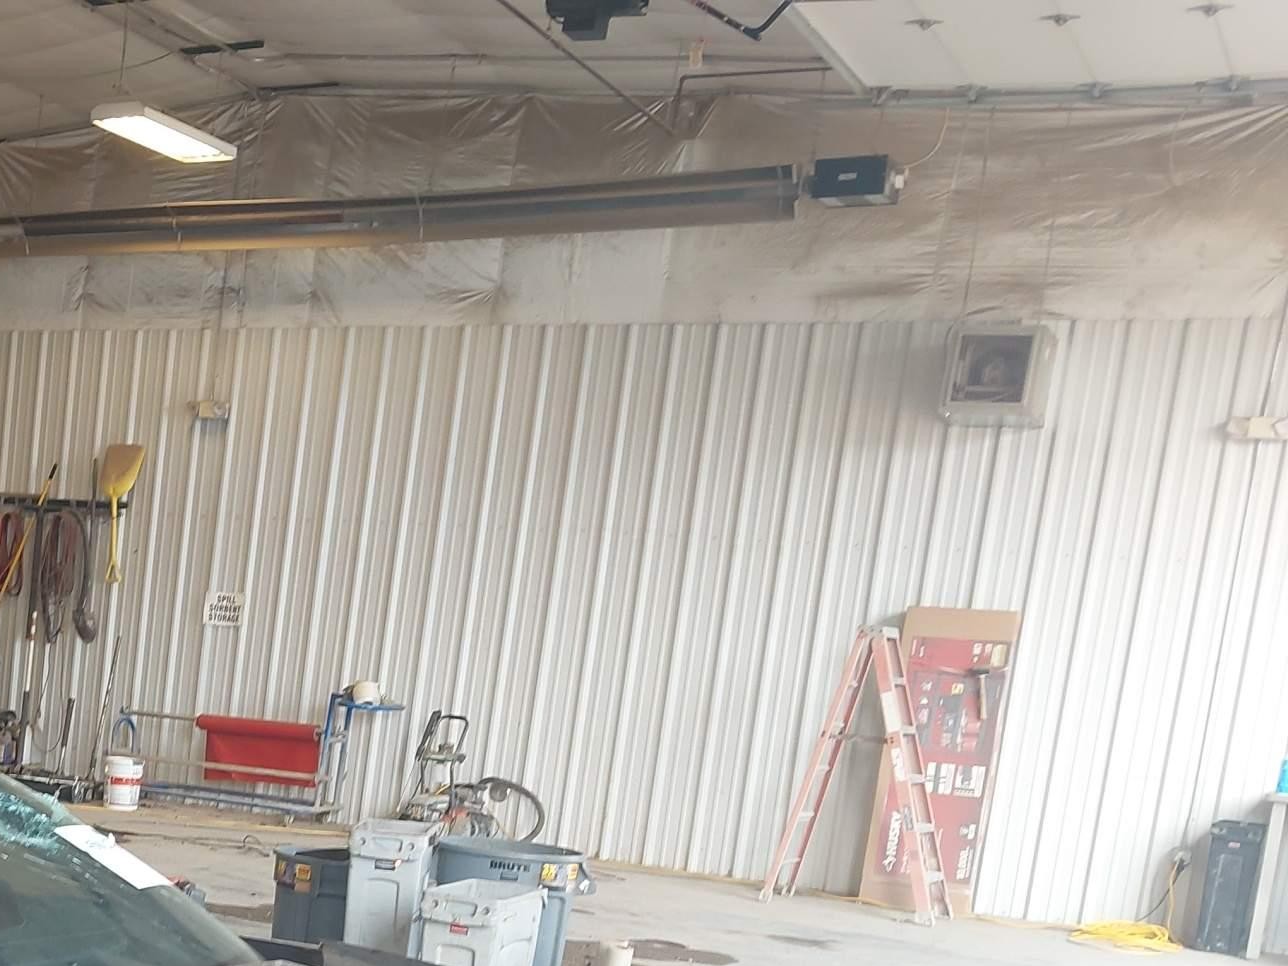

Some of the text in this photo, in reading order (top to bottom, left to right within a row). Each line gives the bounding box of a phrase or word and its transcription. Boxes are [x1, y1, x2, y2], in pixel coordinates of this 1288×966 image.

[217, 595, 235, 603] SPILL
[208, 613, 239, 623] STORAGE
[489, 860, 530, 873] BRUTE
